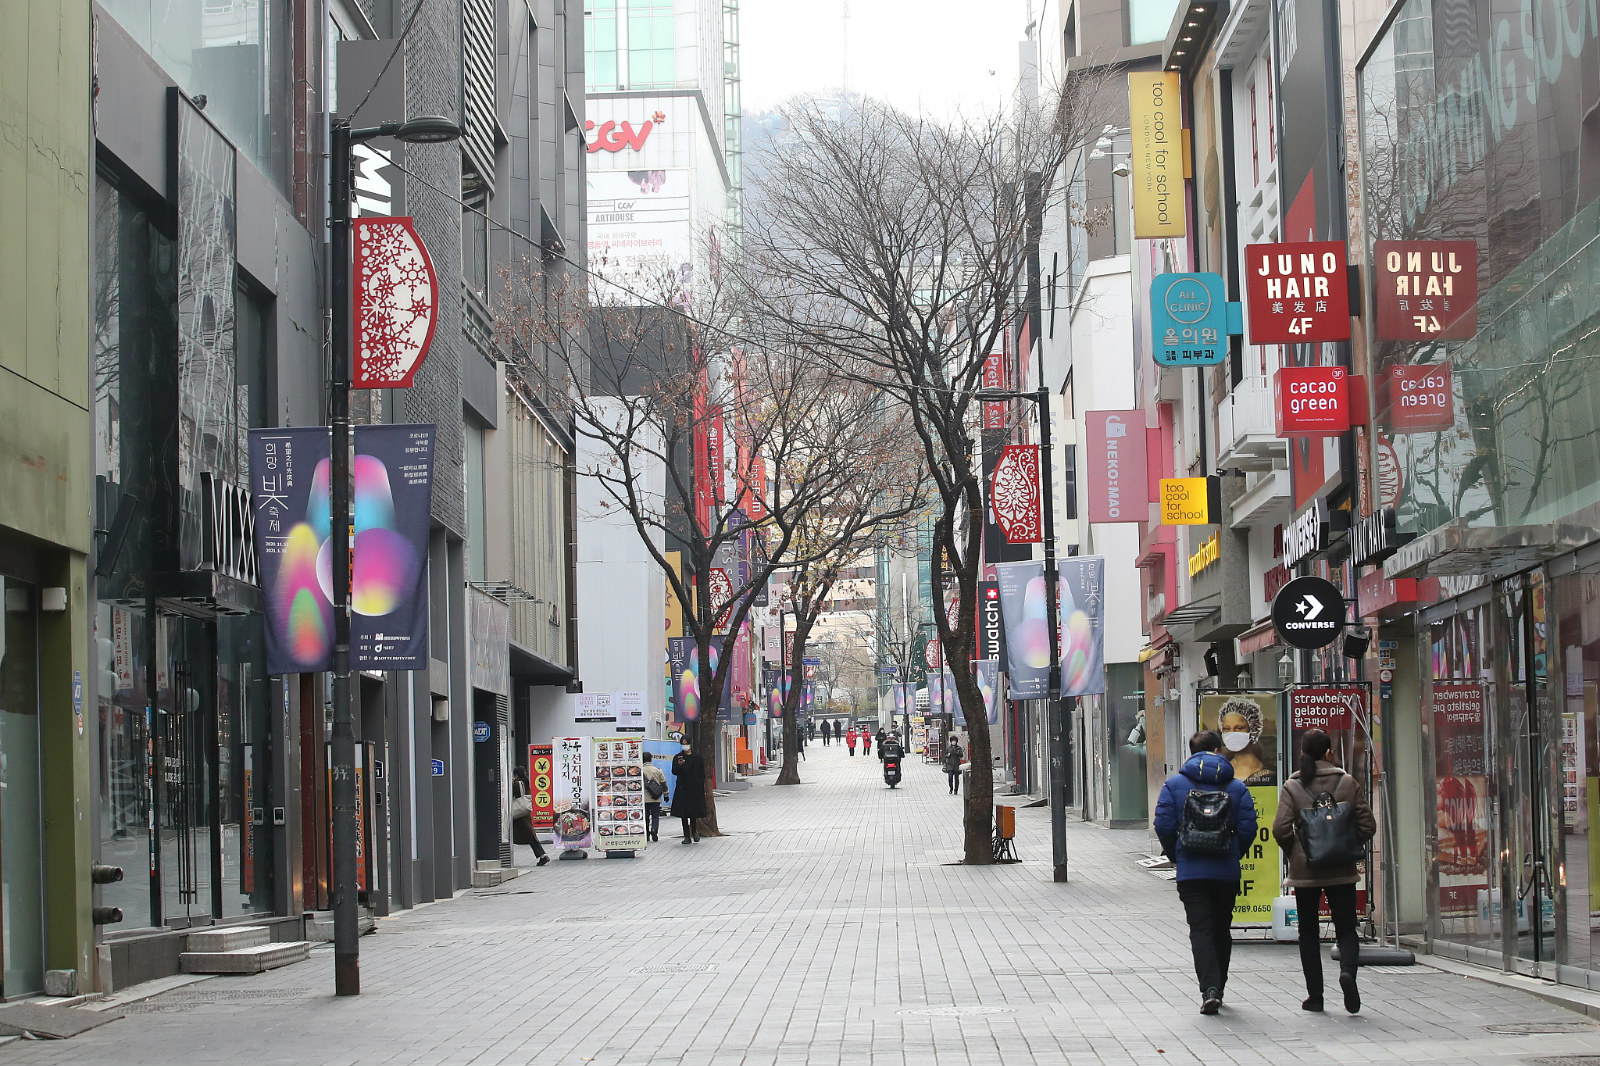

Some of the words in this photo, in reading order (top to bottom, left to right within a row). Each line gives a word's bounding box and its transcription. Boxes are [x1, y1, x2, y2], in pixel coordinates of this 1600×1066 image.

[1152, 82, 1164, 107] too
[1153, 111, 1168, 144] cool
[1155, 149, 1169, 170] for
[1156, 174, 1171, 226] school
[595, 213, 635, 222] ARTHOUSE
[1258, 251, 1337, 277] JUNO
[1267, 276, 1330, 299] HAIR
[1179, 290, 1197, 299] ALL
[1170, 302, 1206, 313] CLINIC
[1272, 301, 1327, 313] 美发店
[1288, 317, 1313, 335] 4F
[1163, 327, 1217, 346] 올의원
[1182, 349, 1214, 360] 피부과
[1290, 381, 1337, 394] cacao
[1290, 397, 1338, 414] green
[1165, 483, 1185, 493] too
[1165, 490, 1190, 501] cool
[1166, 500, 1182, 511] for
[1166, 509, 1204, 520] school
[1285, 621, 1335, 631] CONVERSE
[1294, 705, 1327, 718] gelato
[1330, 705, 1345, 717] pie
[1294, 717, 1329, 728] 딸구파이
